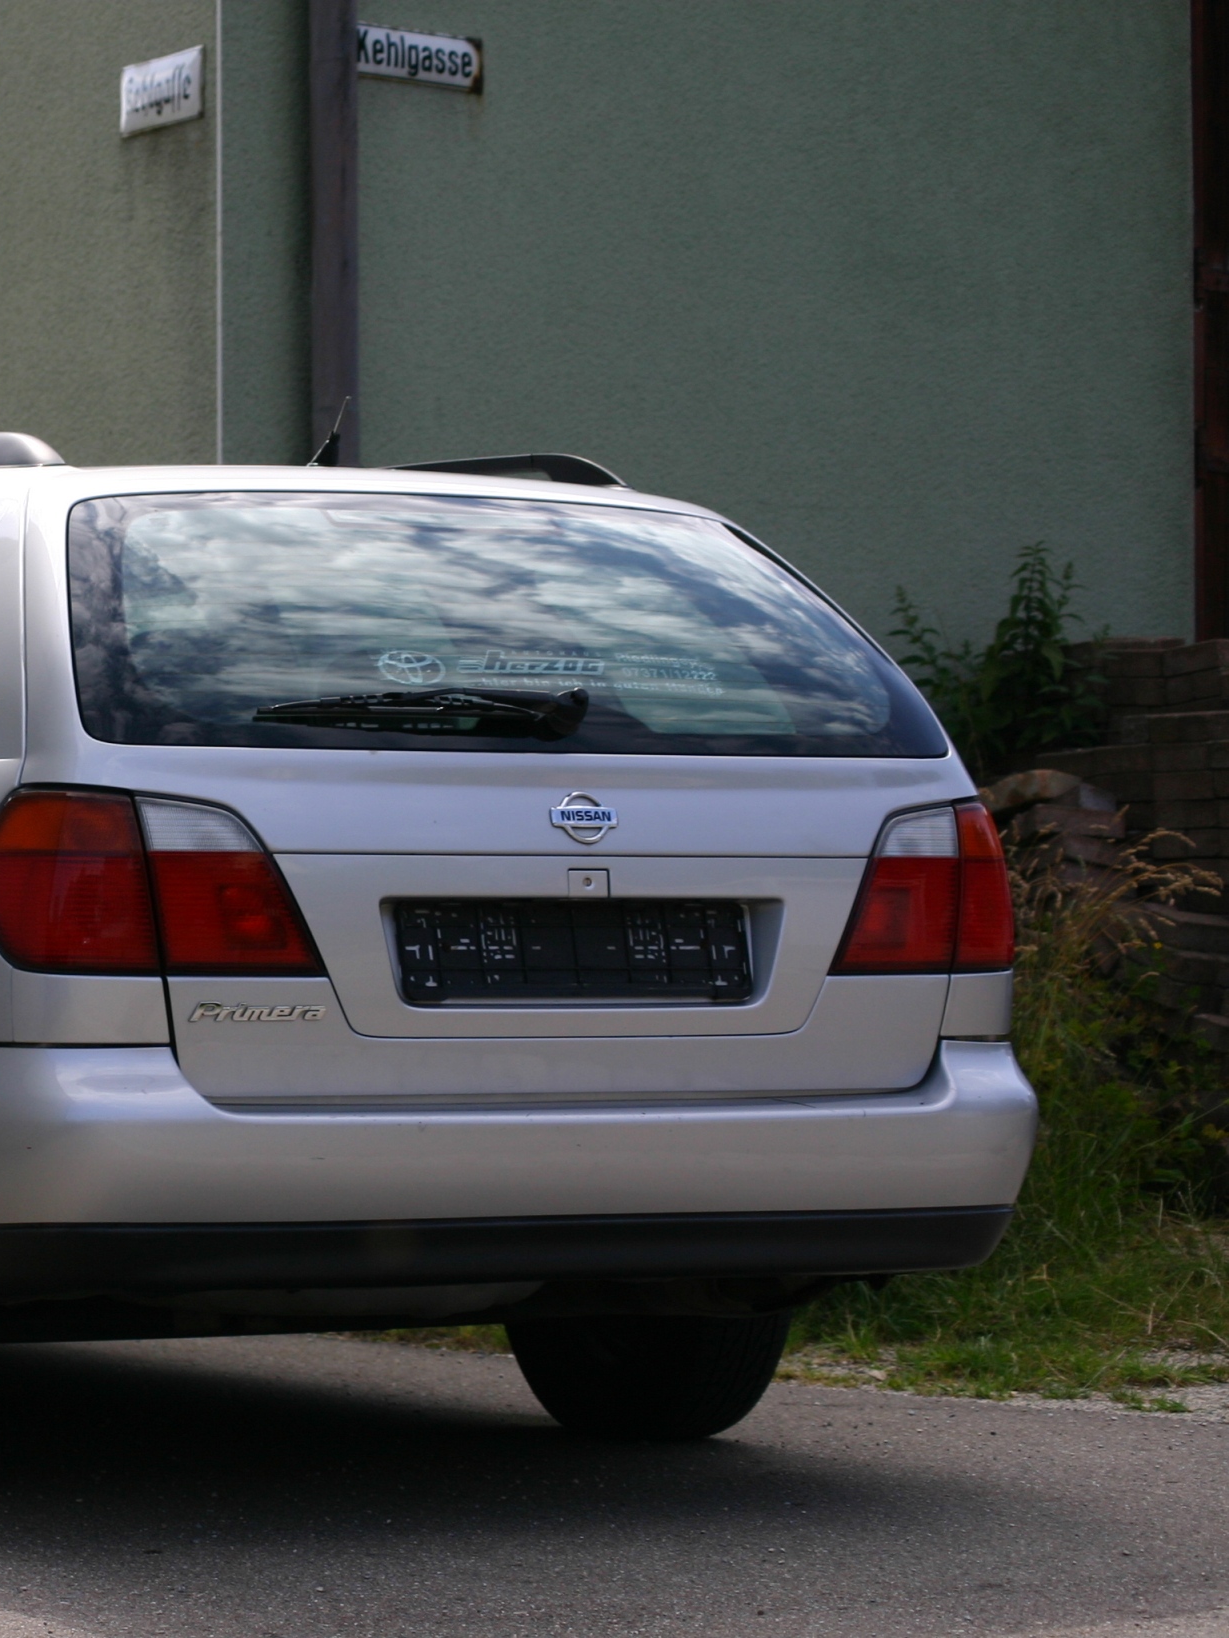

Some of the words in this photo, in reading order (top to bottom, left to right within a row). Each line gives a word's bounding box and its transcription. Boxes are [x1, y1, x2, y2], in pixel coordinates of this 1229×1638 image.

[356, 28, 473, 78] Kehlgasse
[560, 810, 612, 822] NISSAN
[188, 1001, 327, 1022] Primera
